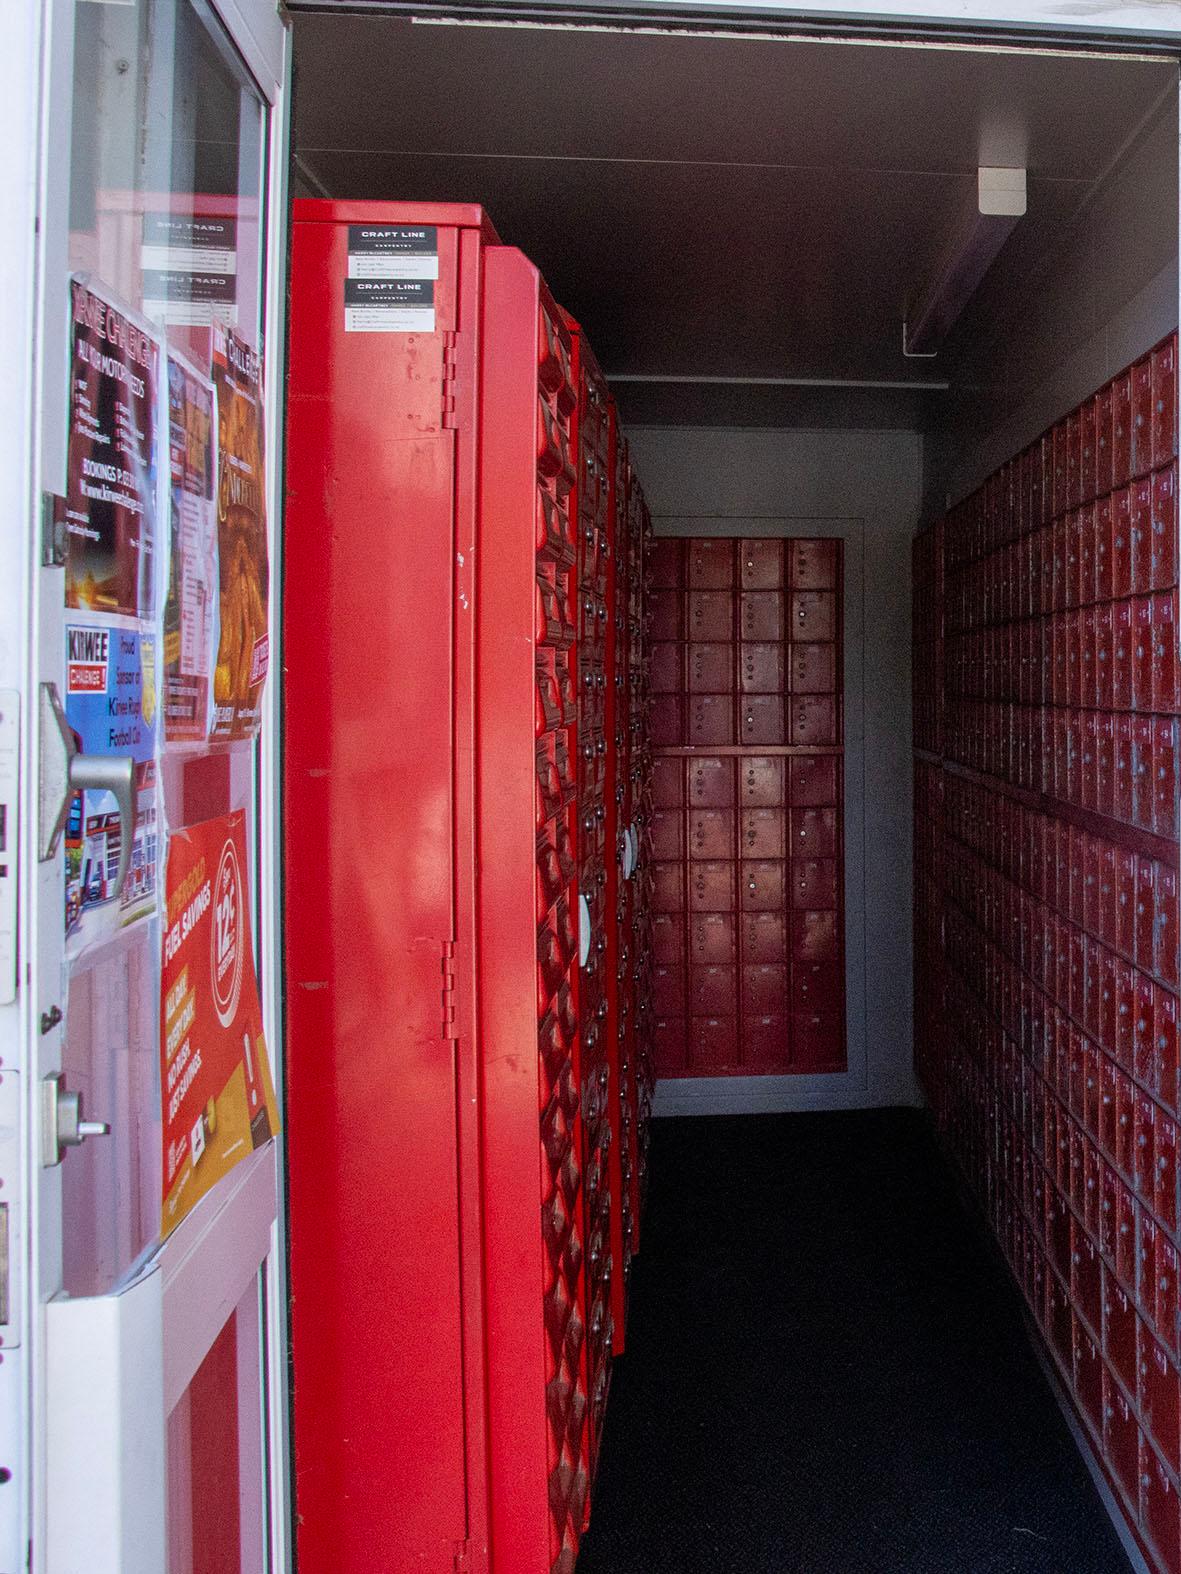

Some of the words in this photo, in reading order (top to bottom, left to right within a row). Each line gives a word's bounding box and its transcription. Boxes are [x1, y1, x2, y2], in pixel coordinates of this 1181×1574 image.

[68, 629, 108, 662] KIRWEE
[164, 920, 182, 968] FUEL
[182, 879, 211, 940] SAVINGS
